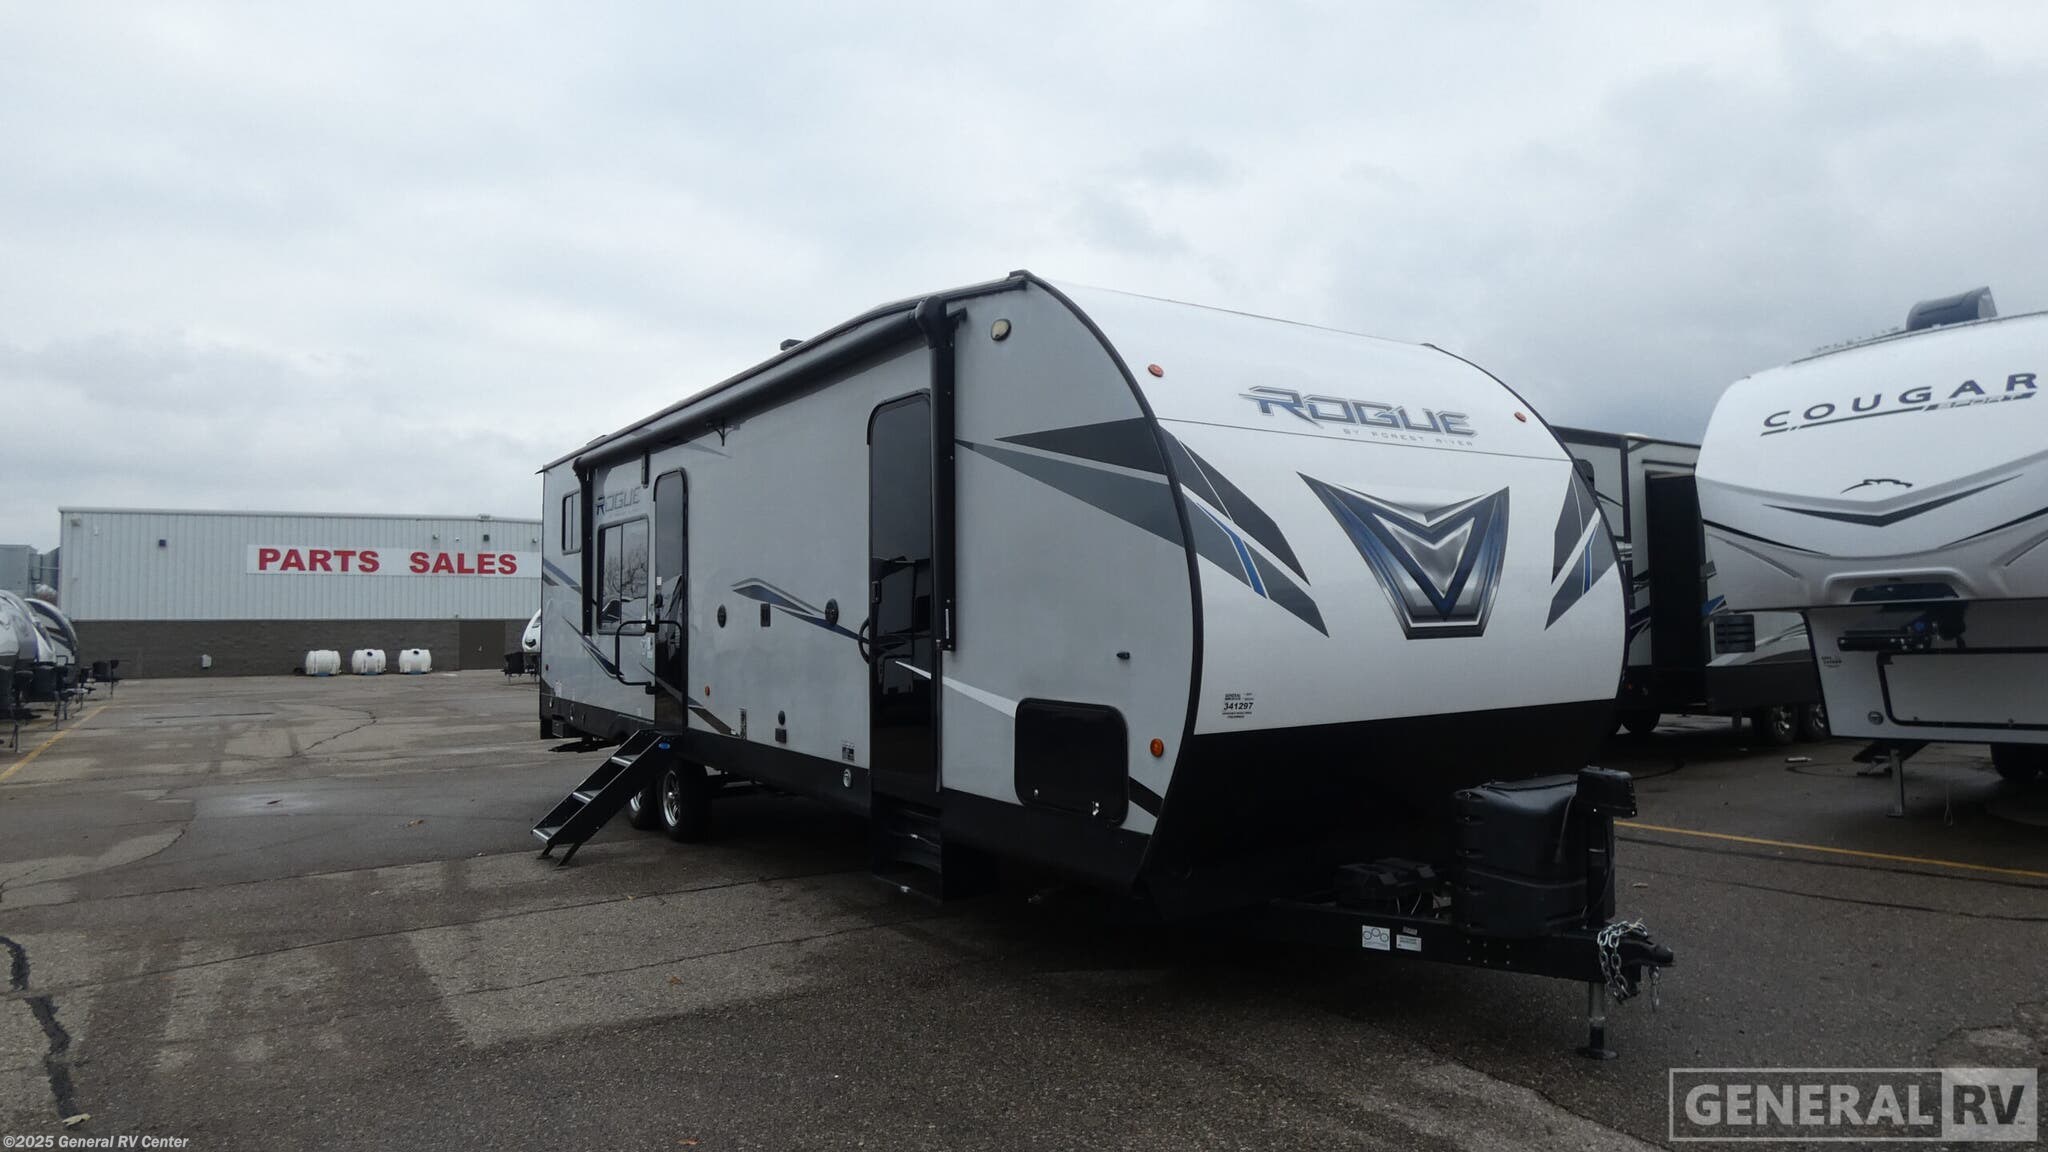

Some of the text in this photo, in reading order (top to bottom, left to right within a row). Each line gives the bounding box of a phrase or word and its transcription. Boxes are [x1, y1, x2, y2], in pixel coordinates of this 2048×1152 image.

[1239, 385, 1478, 437] ROGUE
[1763, 373, 2038, 428] COUGAR
[595, 485, 641, 516] ROGUE
[258, 548, 518, 575] PARTS SALES
[1223, 702, 1254, 711] 341297
